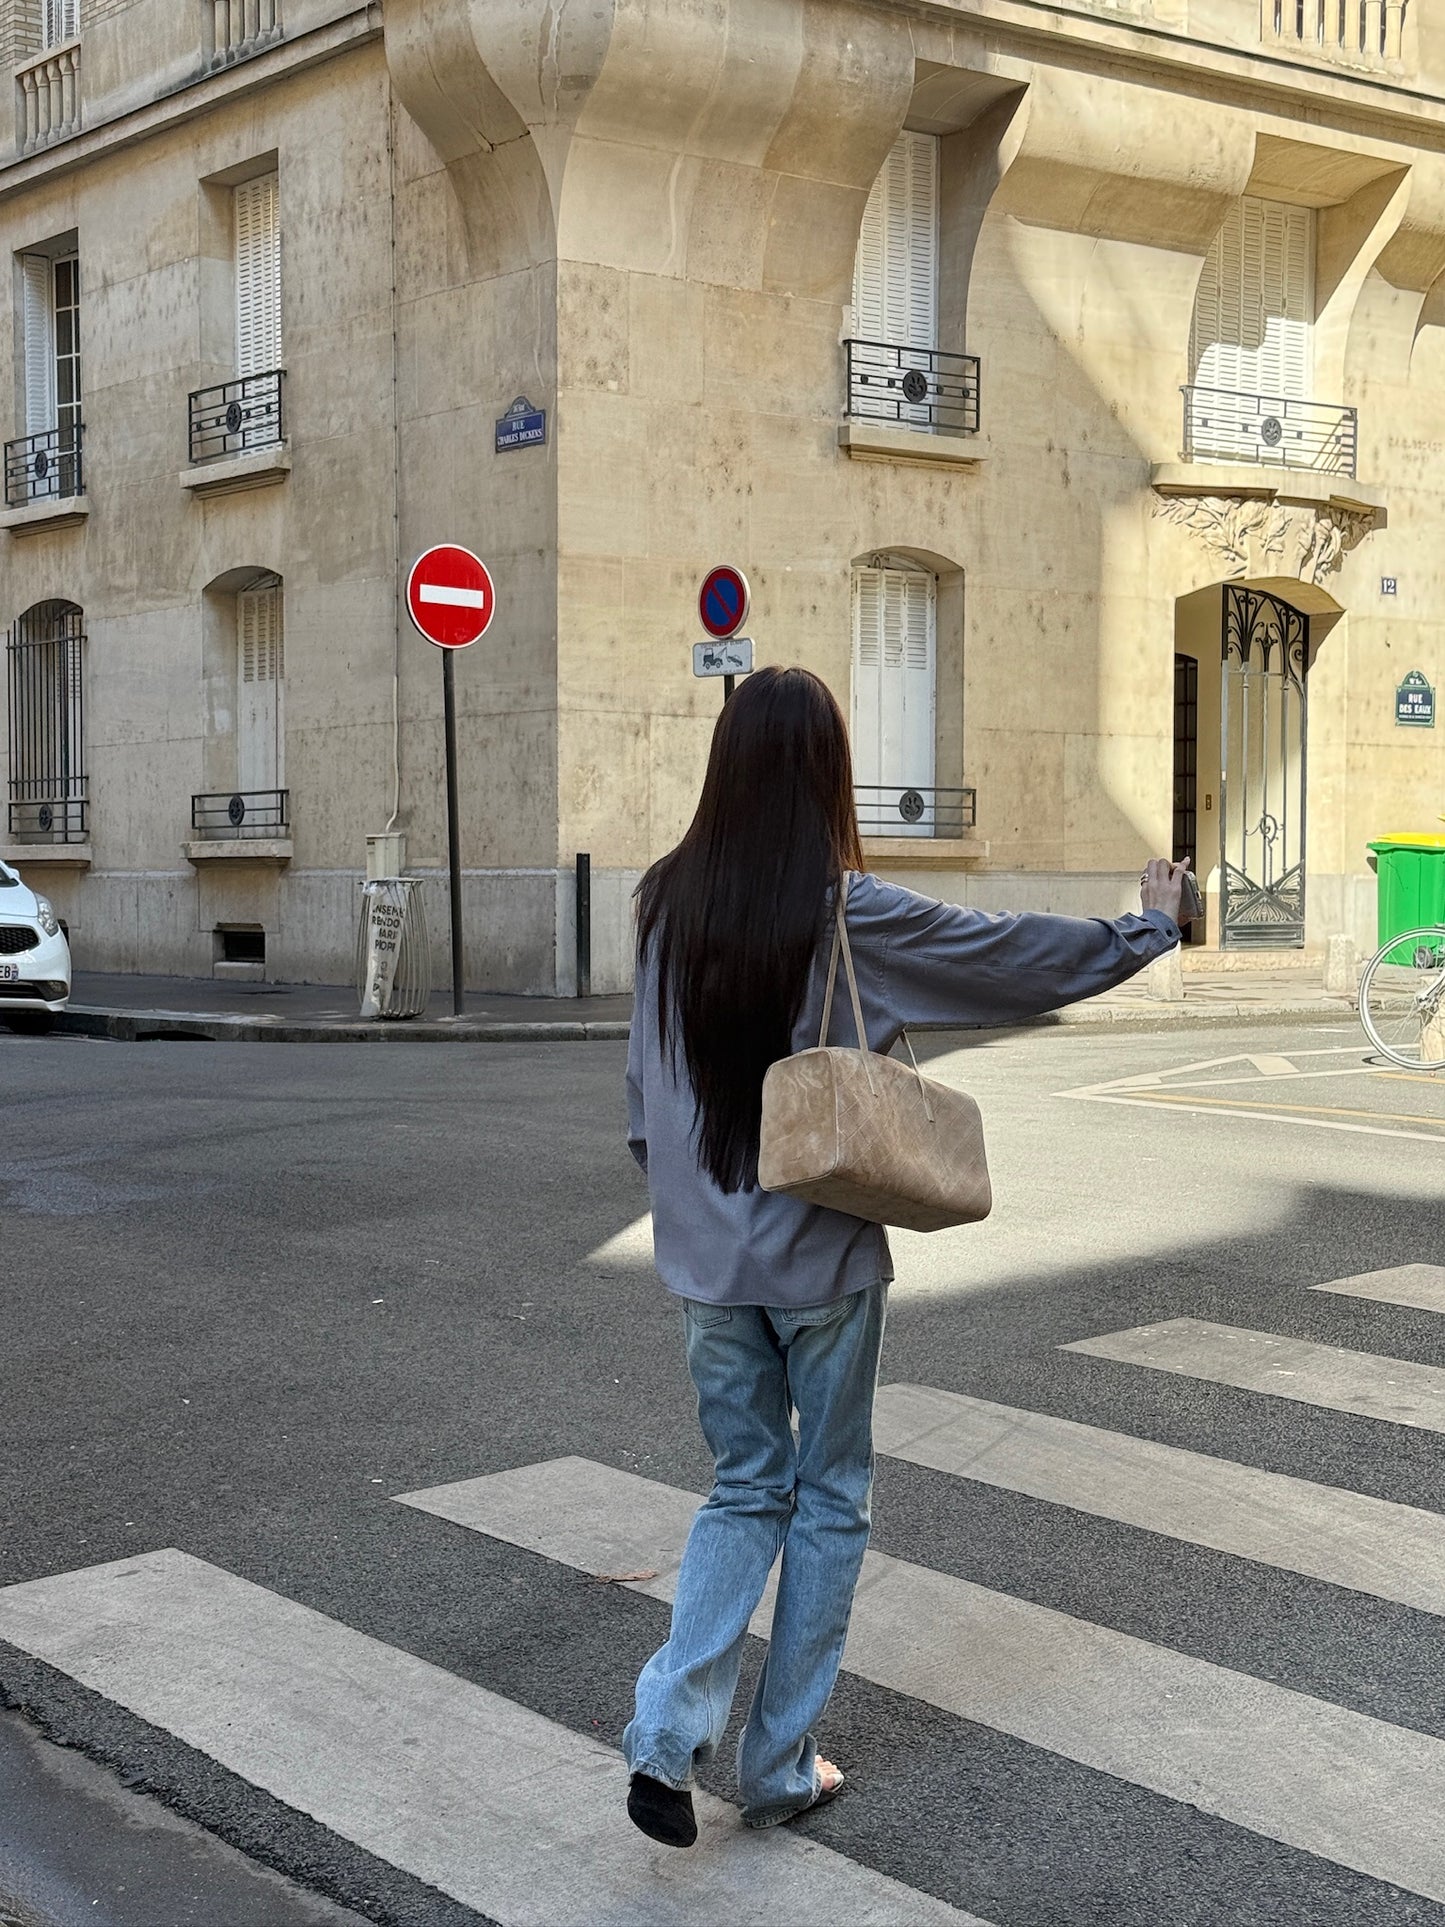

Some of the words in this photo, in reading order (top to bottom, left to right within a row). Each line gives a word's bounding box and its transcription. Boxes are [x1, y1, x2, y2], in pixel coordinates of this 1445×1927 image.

[512, 420, 525, 431] RUE
[498, 433, 519, 446] CHARLES
[519, 429, 543, 441] DICKENS
[1383, 579, 1395, 593] 12
[1408, 693, 1423, 704] RUE
[1398, 703, 1412, 714] DES
[1414, 704, 1432, 715] EAUX
